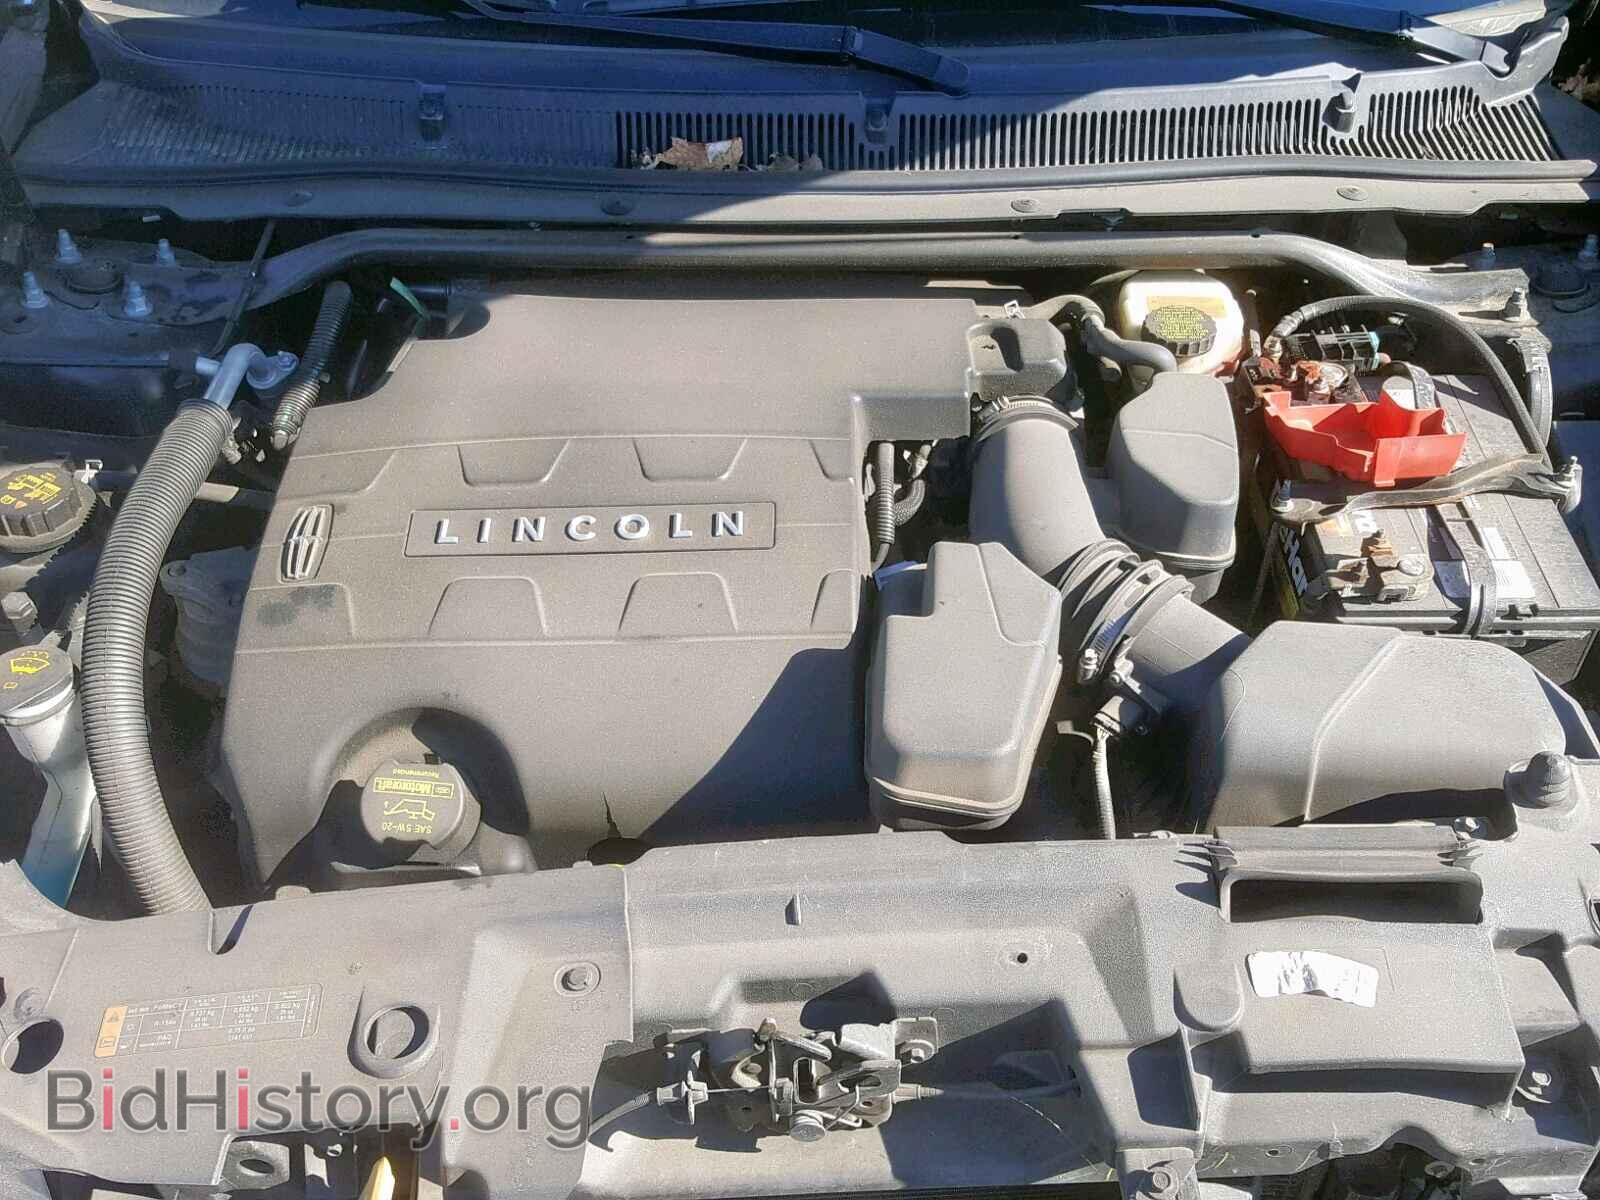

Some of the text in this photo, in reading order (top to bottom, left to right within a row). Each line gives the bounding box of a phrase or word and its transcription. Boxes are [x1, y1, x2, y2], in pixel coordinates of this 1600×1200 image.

[434, 510, 744, 545] LINCOLN
[392, 768, 440, 779] Recommended
[376, 778, 432, 795] Motorcraft
[414, 823, 433, 834] SAE
